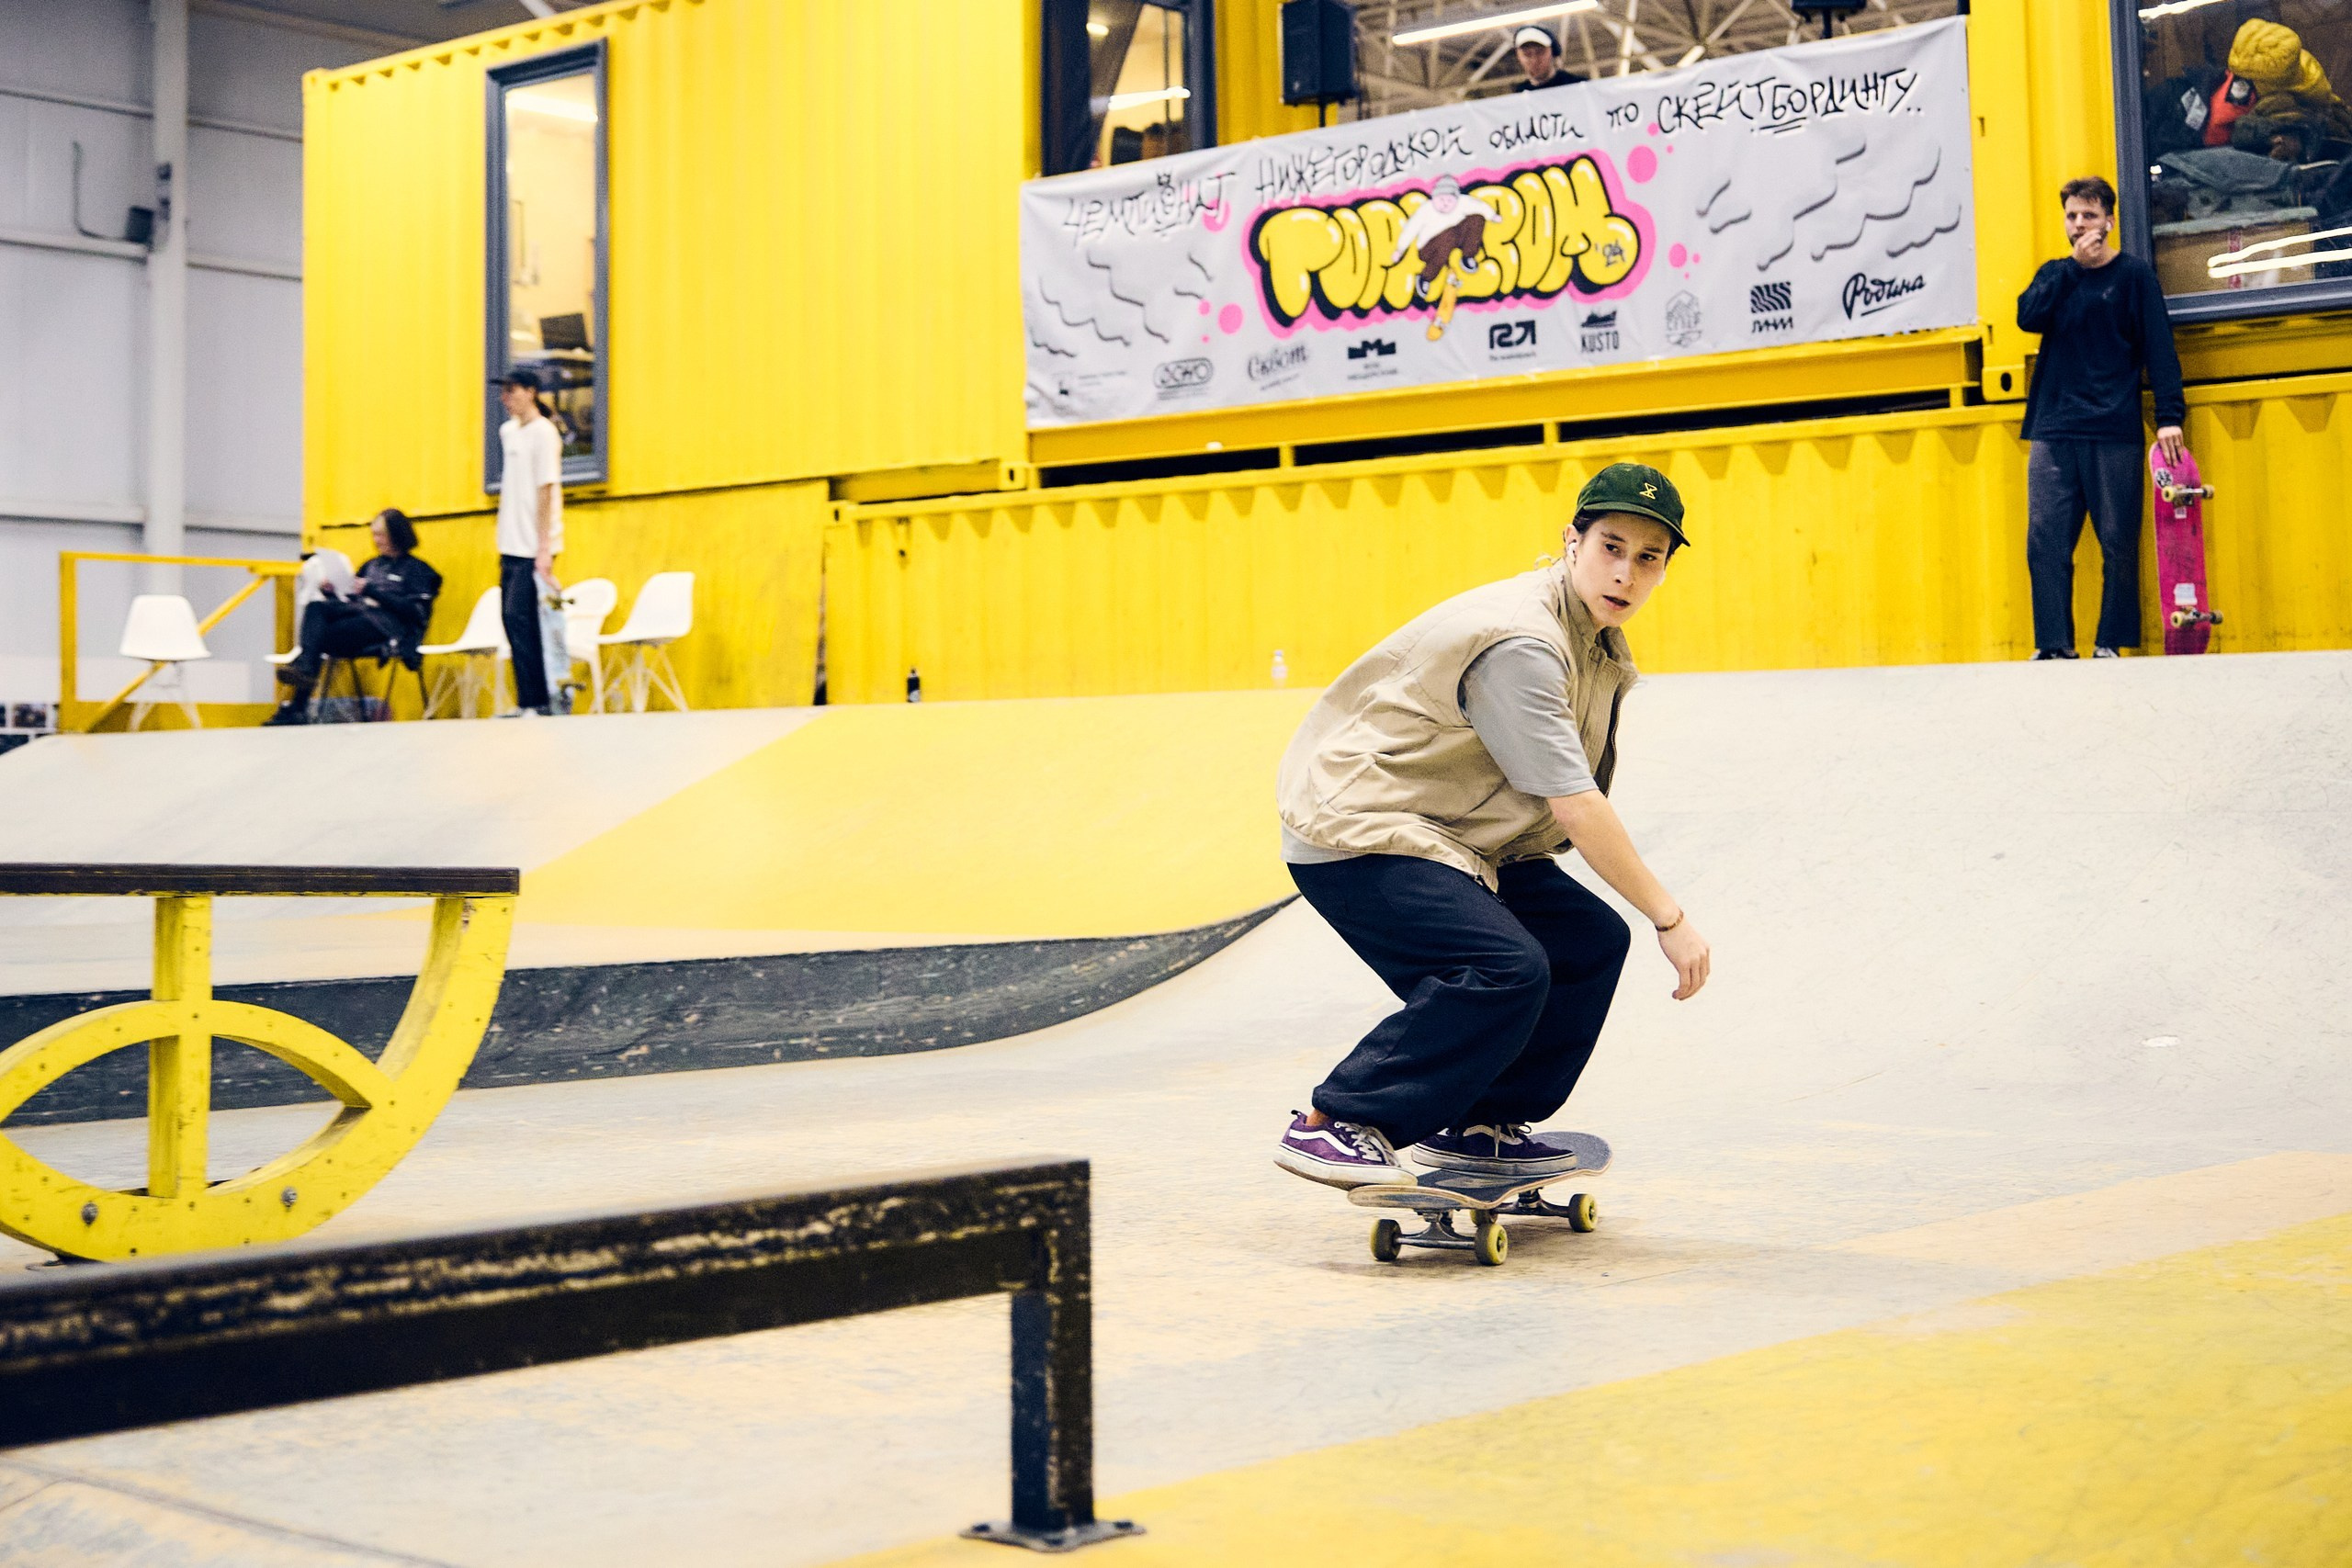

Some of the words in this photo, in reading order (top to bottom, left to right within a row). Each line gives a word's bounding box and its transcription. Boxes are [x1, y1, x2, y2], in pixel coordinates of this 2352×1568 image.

[1255, 125, 1472, 196] НИЖЕГОРОДСКОЙ
[1488, 112, 1585, 149] ОБЛАСТИ
[1607, 102, 1640, 128] ПО
[1842, 272, 1926, 320] Родина
[1581, 330, 1620, 353] KUSTO
